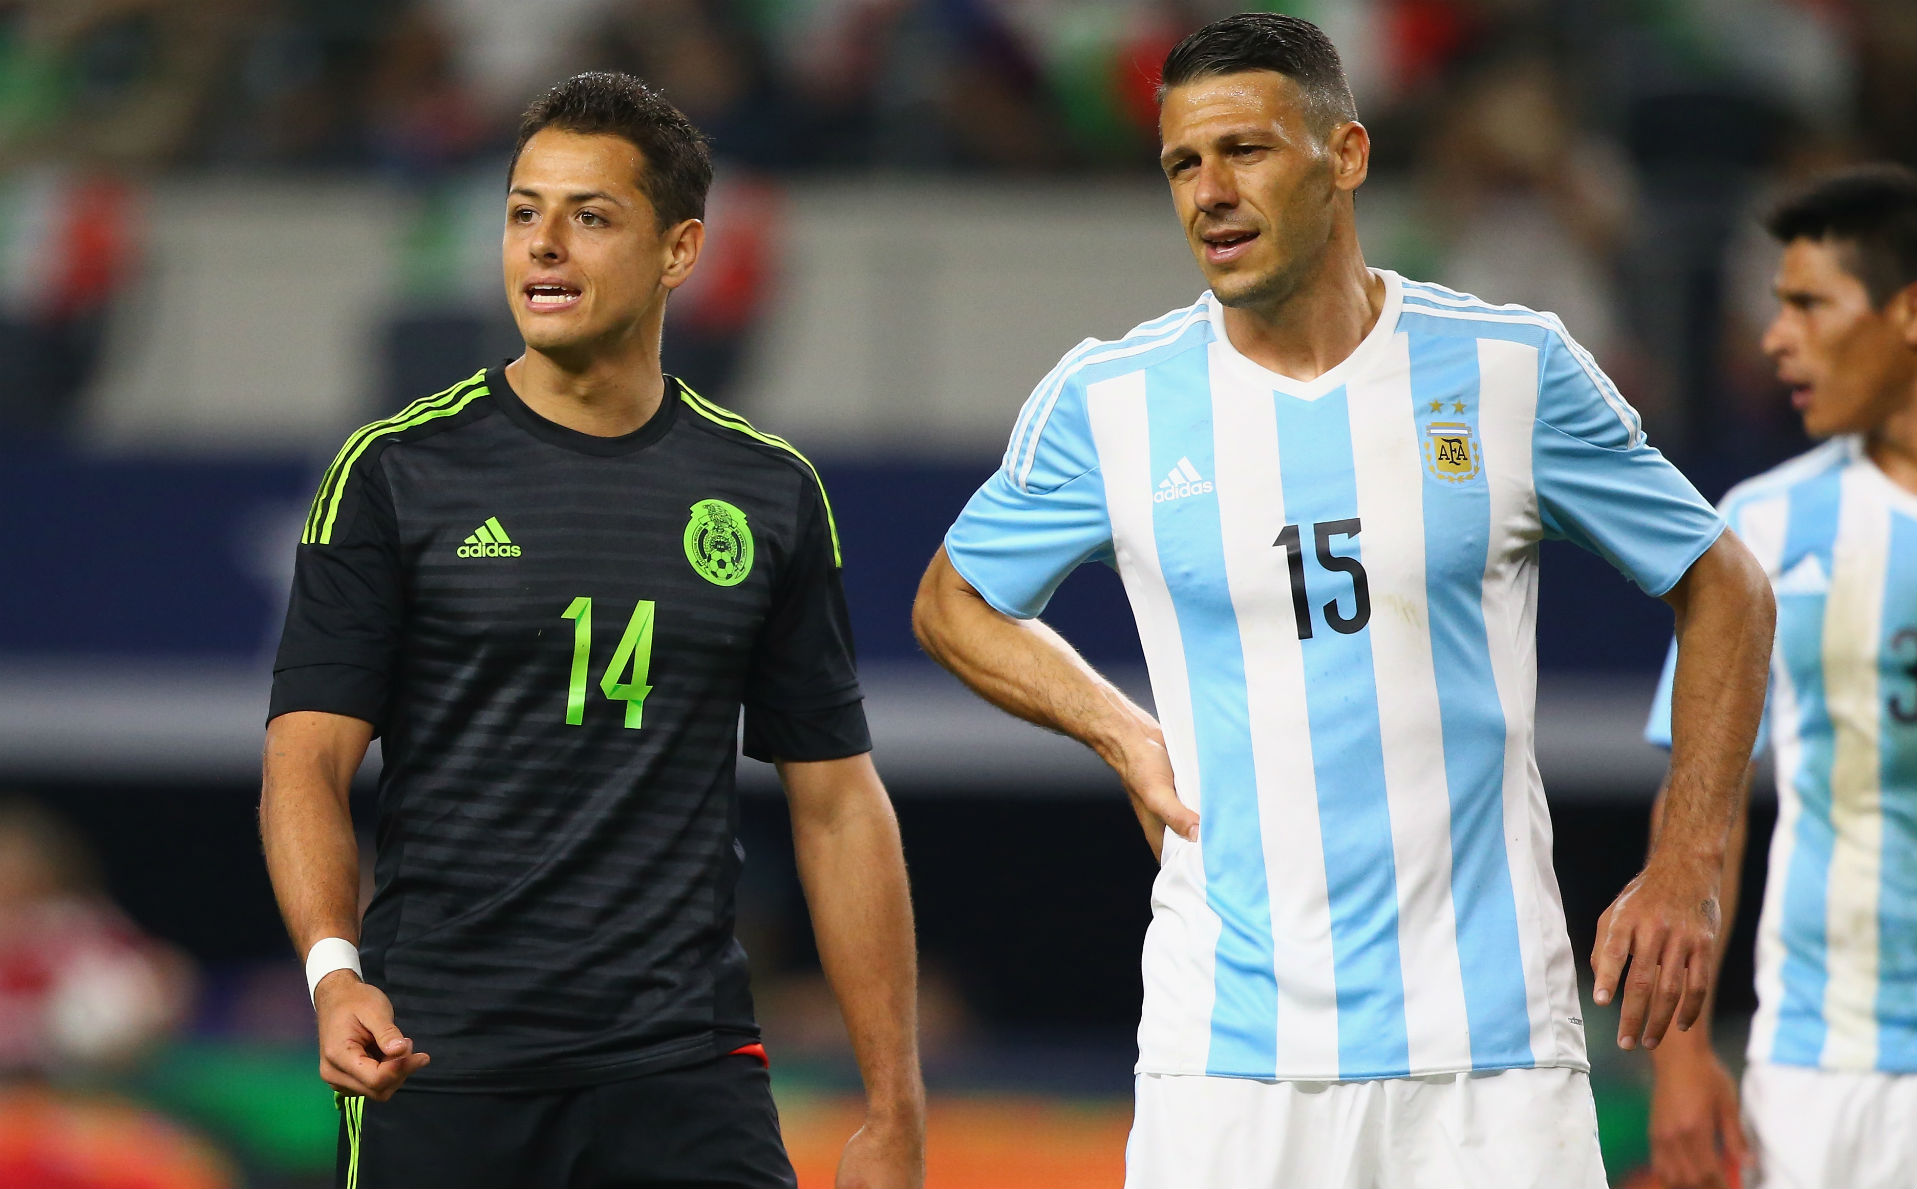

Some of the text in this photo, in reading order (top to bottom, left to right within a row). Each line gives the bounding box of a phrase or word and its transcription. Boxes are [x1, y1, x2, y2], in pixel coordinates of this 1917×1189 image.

[1438, 437, 1468, 466] AFA
[1153, 481, 1214, 503] adidas
[456, 541, 522, 558] adidas
[1272, 517, 1371, 640] 15
[560, 596, 656, 729] 14
